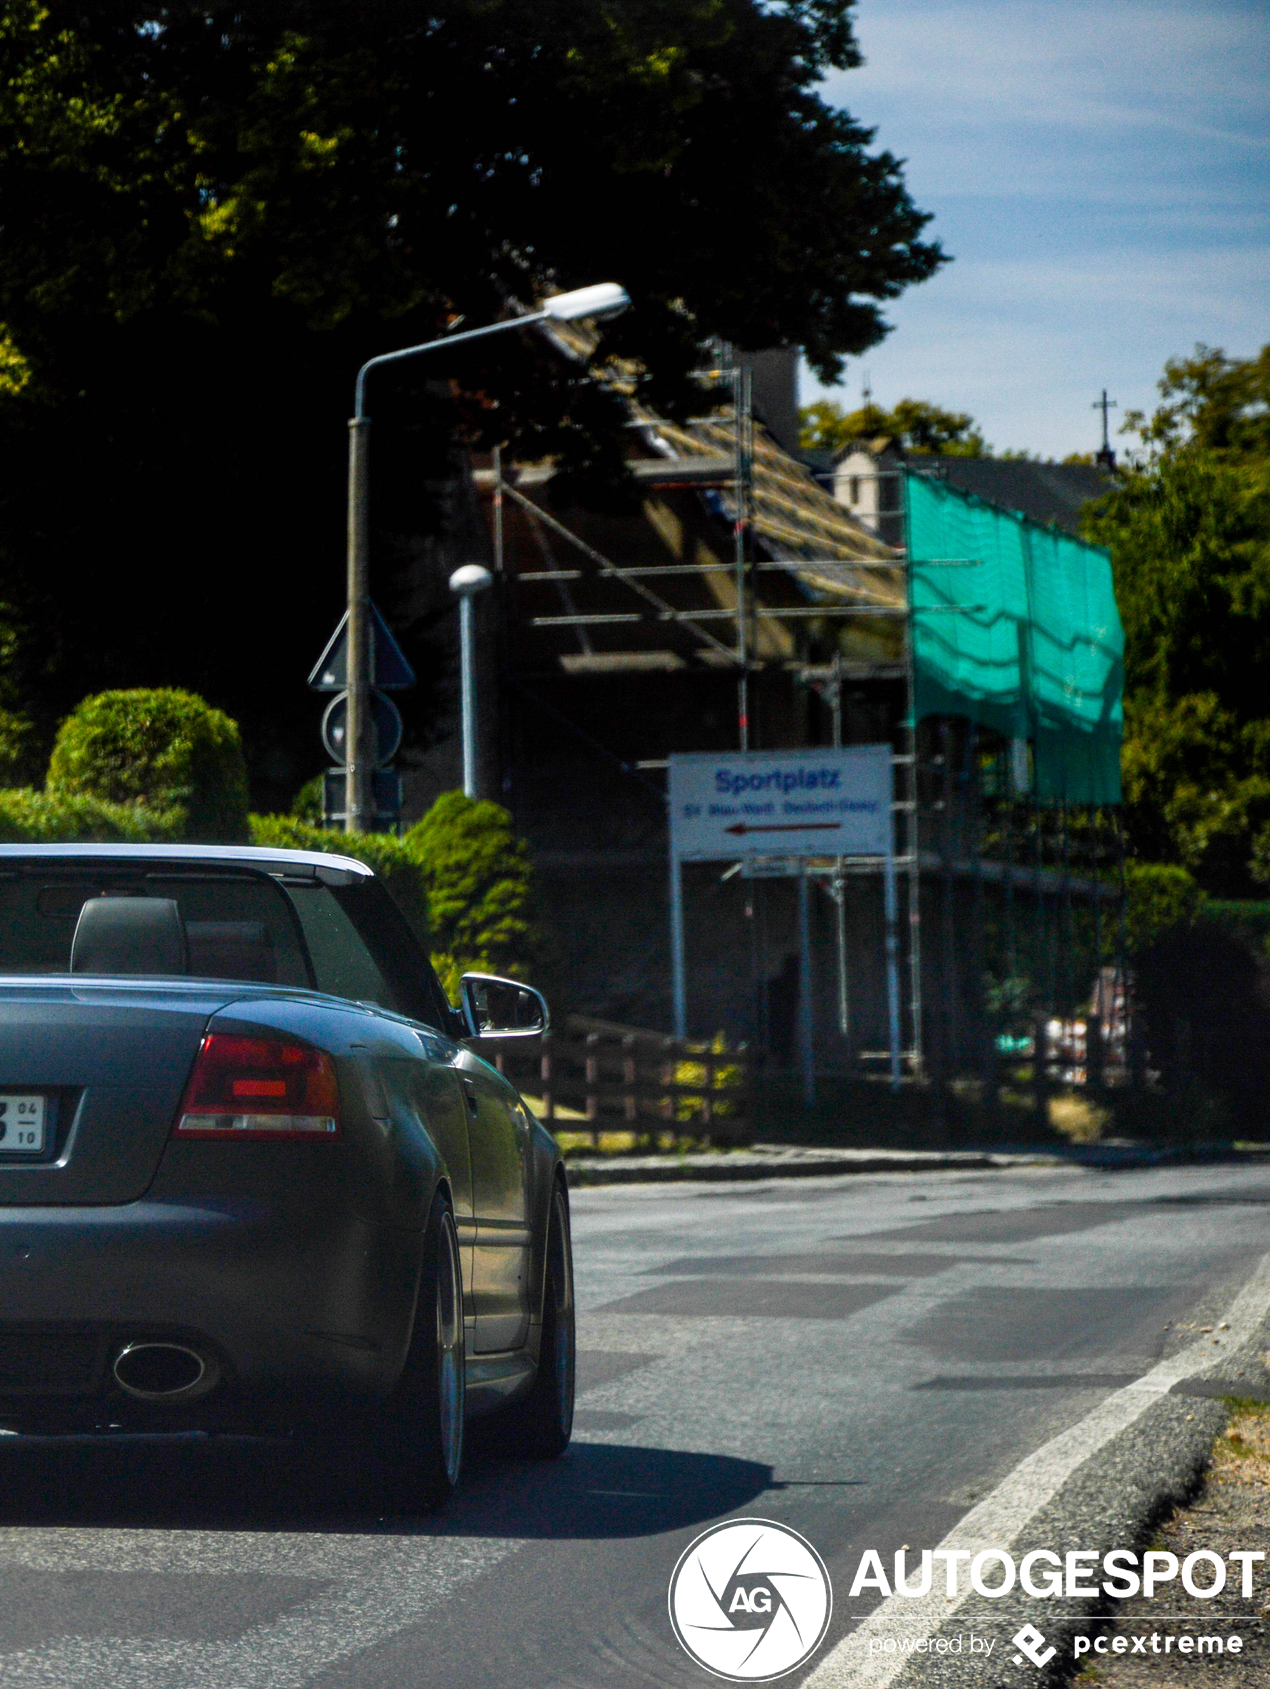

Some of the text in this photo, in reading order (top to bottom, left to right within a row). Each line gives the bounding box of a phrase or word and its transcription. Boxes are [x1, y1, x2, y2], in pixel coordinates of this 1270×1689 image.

[715, 767, 840, 795] Sportplatz
[18, 1102, 36, 1115] 04
[18, 1131, 35, 1144] 10
